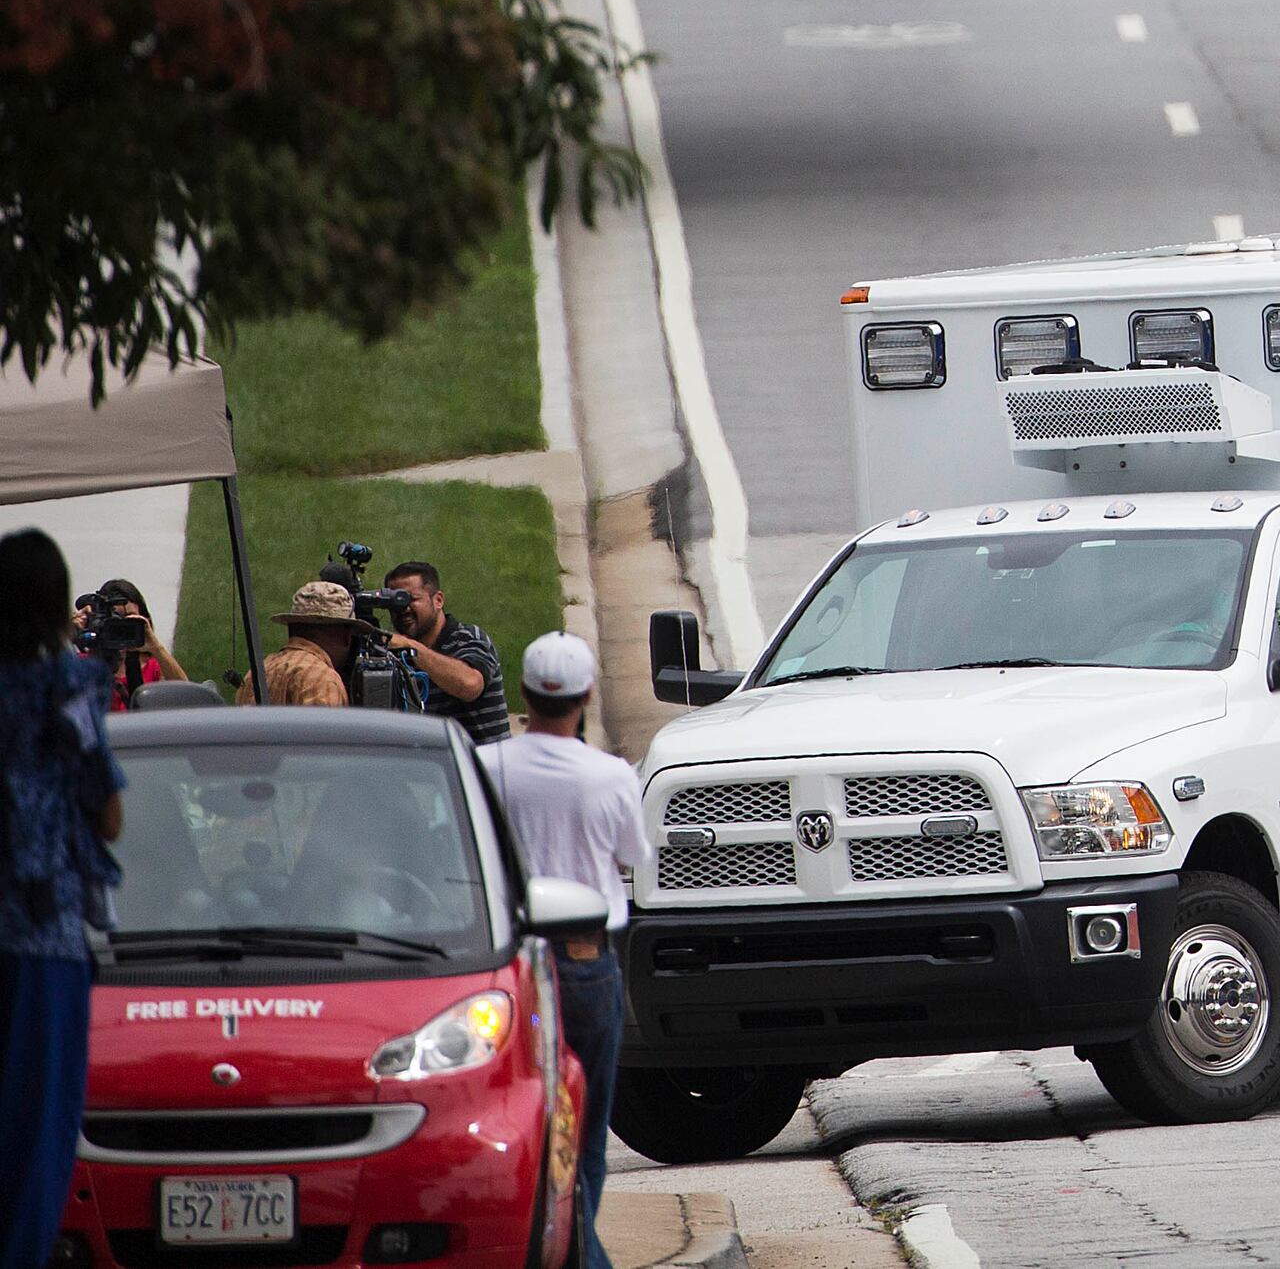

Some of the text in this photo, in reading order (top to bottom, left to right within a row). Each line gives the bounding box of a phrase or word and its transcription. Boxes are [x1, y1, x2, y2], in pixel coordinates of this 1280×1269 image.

[126, 998, 324, 1021] FREE DELIVERY
[167, 1191, 286, 1229] E52 7CC
